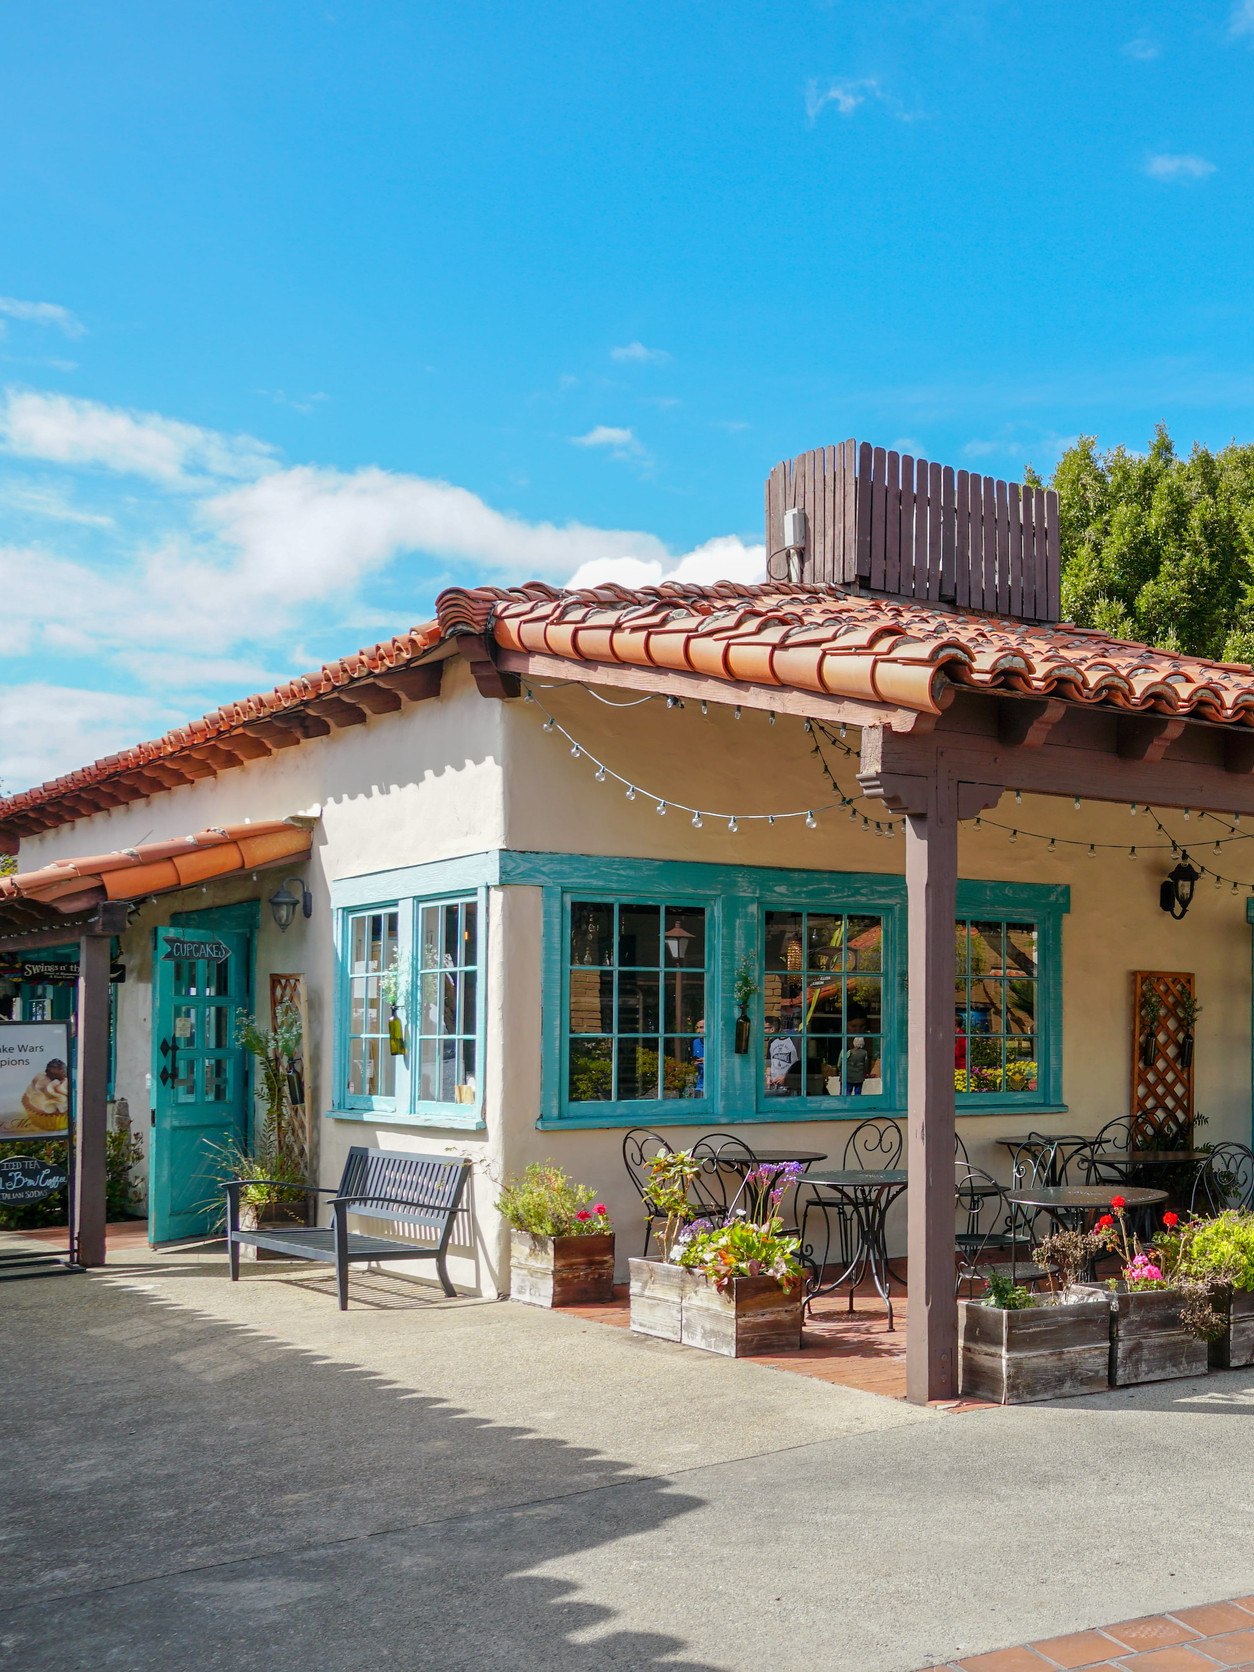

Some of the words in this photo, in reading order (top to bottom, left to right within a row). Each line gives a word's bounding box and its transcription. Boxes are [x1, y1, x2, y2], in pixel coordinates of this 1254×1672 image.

[173, 942, 226, 958] CUPCAKES
[17, 1044, 44, 1053] Wars
[1, 1161, 22, 1170] ICED
[22, 1160, 40, 1169] TEA
[39, 1168, 68, 1189] Coffee
[25, 1189, 48, 1199] SODAS
